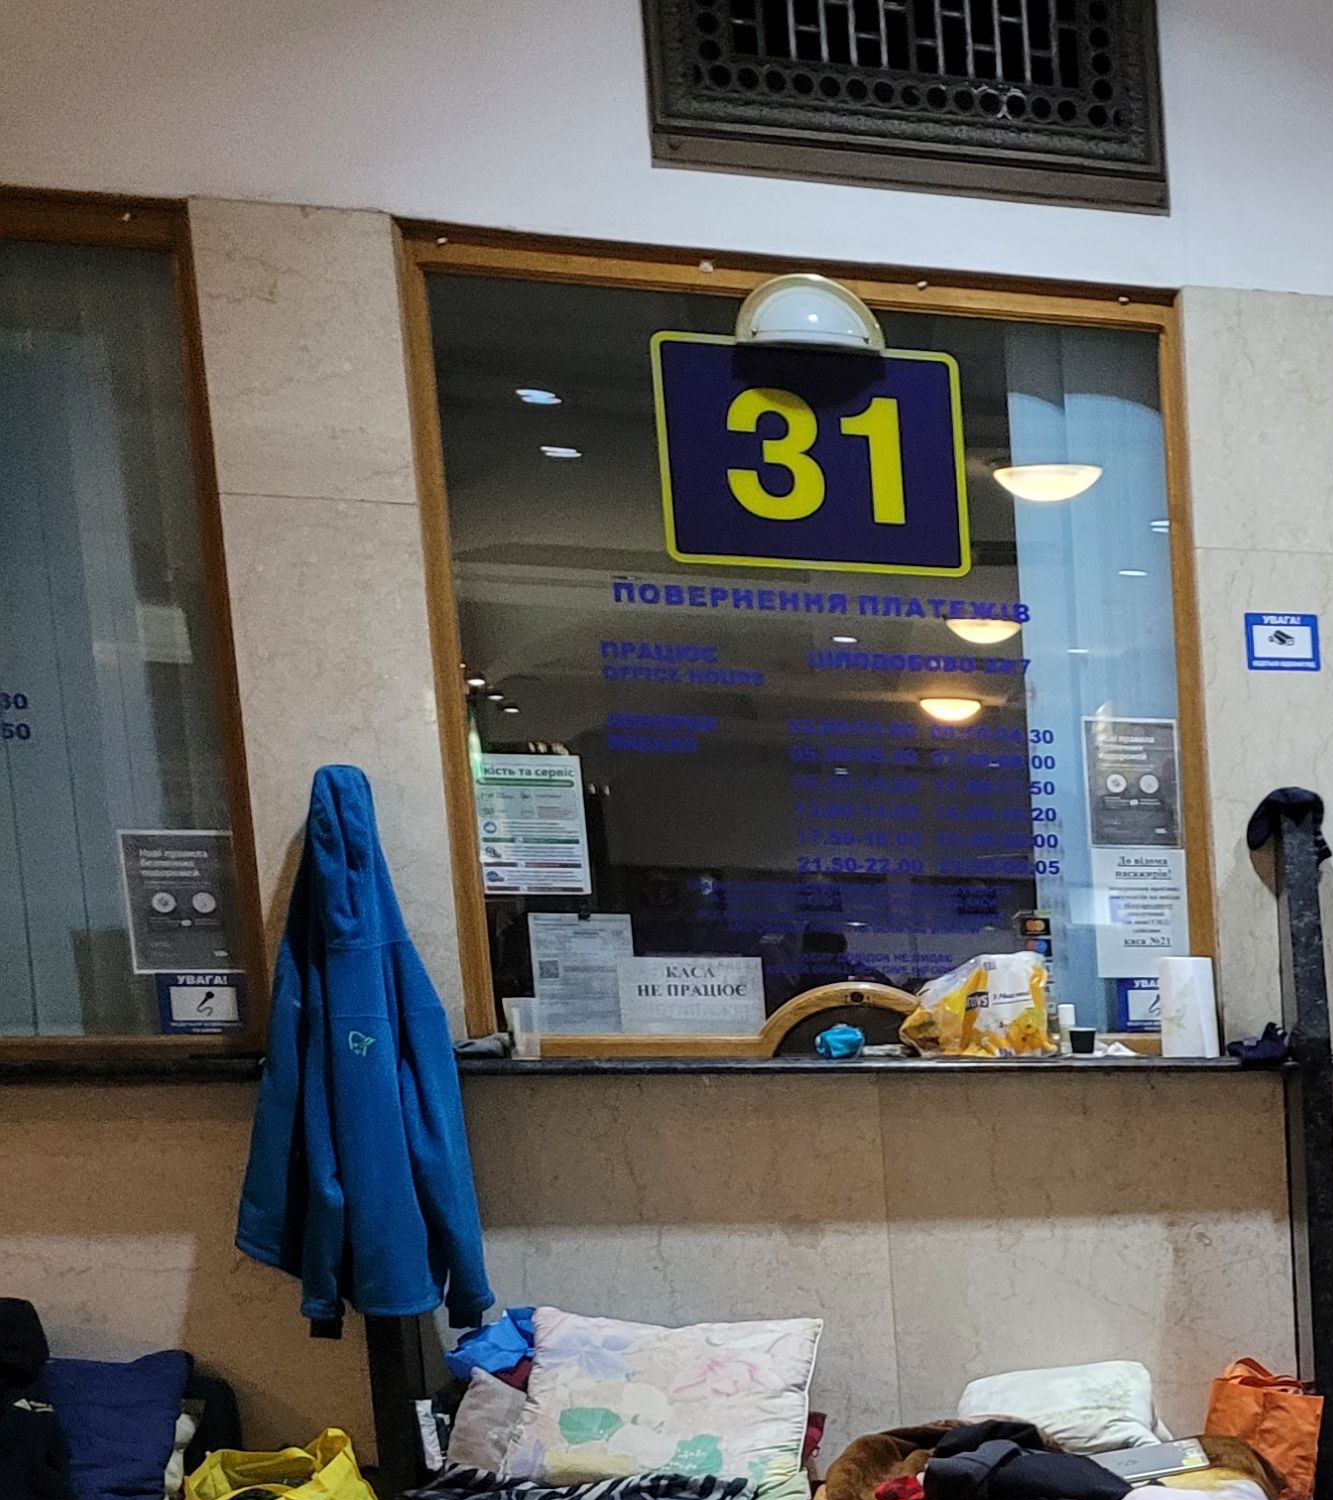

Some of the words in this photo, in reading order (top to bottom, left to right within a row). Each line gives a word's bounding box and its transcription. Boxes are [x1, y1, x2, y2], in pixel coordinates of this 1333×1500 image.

[725, 388, 906, 525] 31
[613, 581, 846, 615] ПОВЕРНЕННЯ
[858, 594, 1030, 623] ПЛАТЕЖІВ
[481, 766, 515, 776] кість
[665, 966, 715, 979] КАСА
[176, 974, 228, 985] УВАГА!
[637, 984, 662, 997] НЕ
[667, 984, 747, 998] ПРАЦЮЄ
